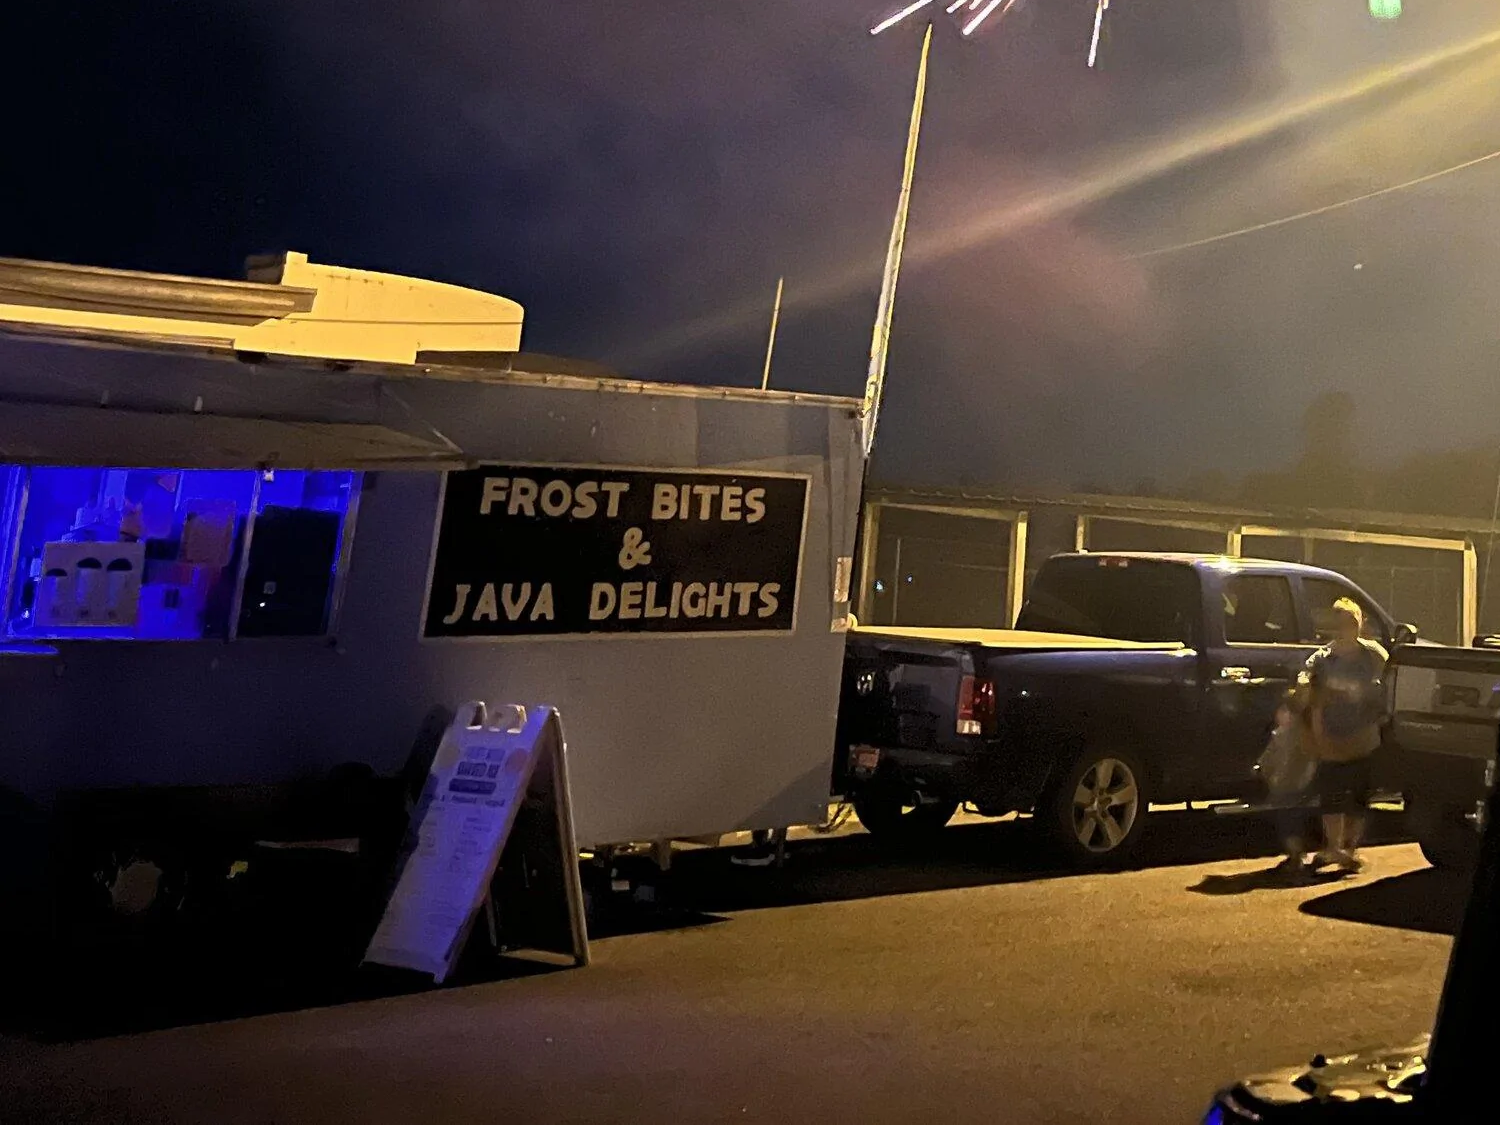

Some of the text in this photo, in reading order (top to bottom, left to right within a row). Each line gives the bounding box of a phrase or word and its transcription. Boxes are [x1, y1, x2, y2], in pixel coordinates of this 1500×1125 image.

[479, 477, 766, 523] FROST BITES
[618, 527, 651, 570] &
[443, 581, 781, 624] JAVA DELIGHTS
